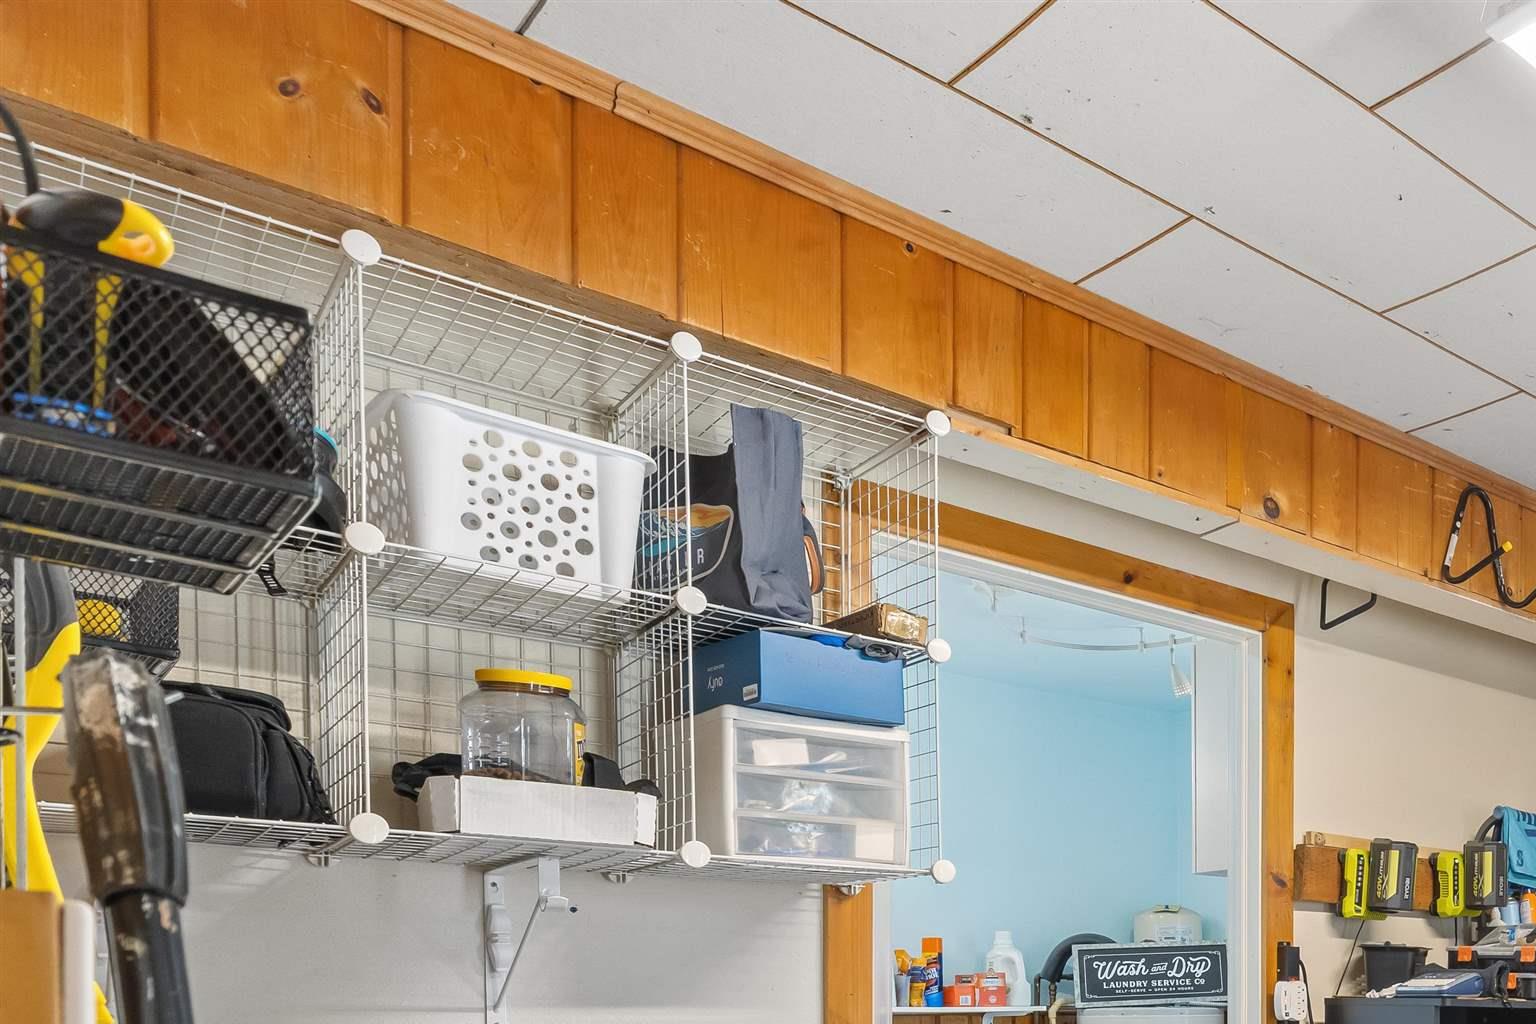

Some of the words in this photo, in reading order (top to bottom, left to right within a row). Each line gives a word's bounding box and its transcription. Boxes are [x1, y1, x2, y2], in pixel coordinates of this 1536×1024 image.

[1093, 958, 1149, 980] Wash
[1151, 963, 1168, 972] and
[1167, 956, 1211, 978] Dry
[1103, 980, 1148, 989] LAUNDRY
[1151, 979, 1192, 987] SERVICE
